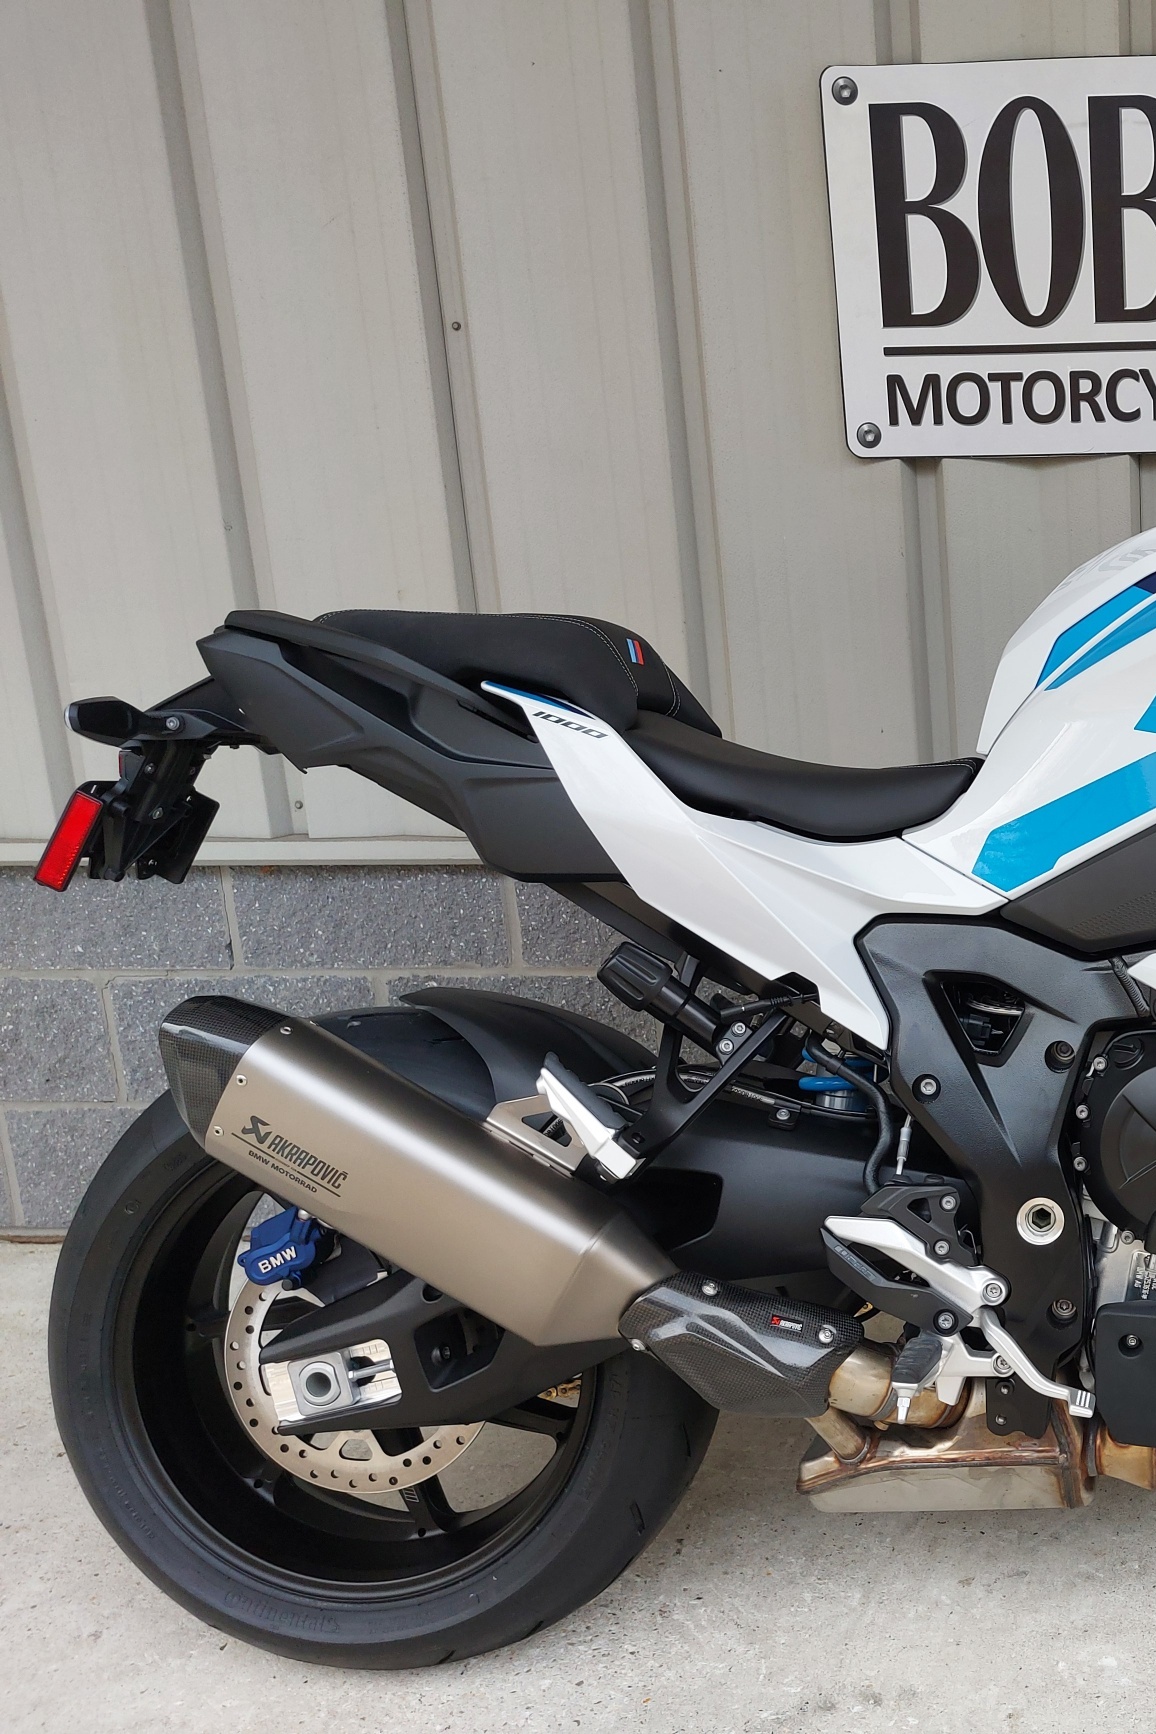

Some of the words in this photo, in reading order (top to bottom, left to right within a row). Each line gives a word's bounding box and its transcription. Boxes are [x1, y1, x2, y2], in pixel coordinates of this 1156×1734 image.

[532, 711, 609, 739] 1000
[248, 1149, 271, 1166] BMW
[270, 1162, 318, 1194] MOTORRAD
[267, 1134, 349, 1190] AKRAPOVIČ
[257, 1246, 297, 1274] BMW
